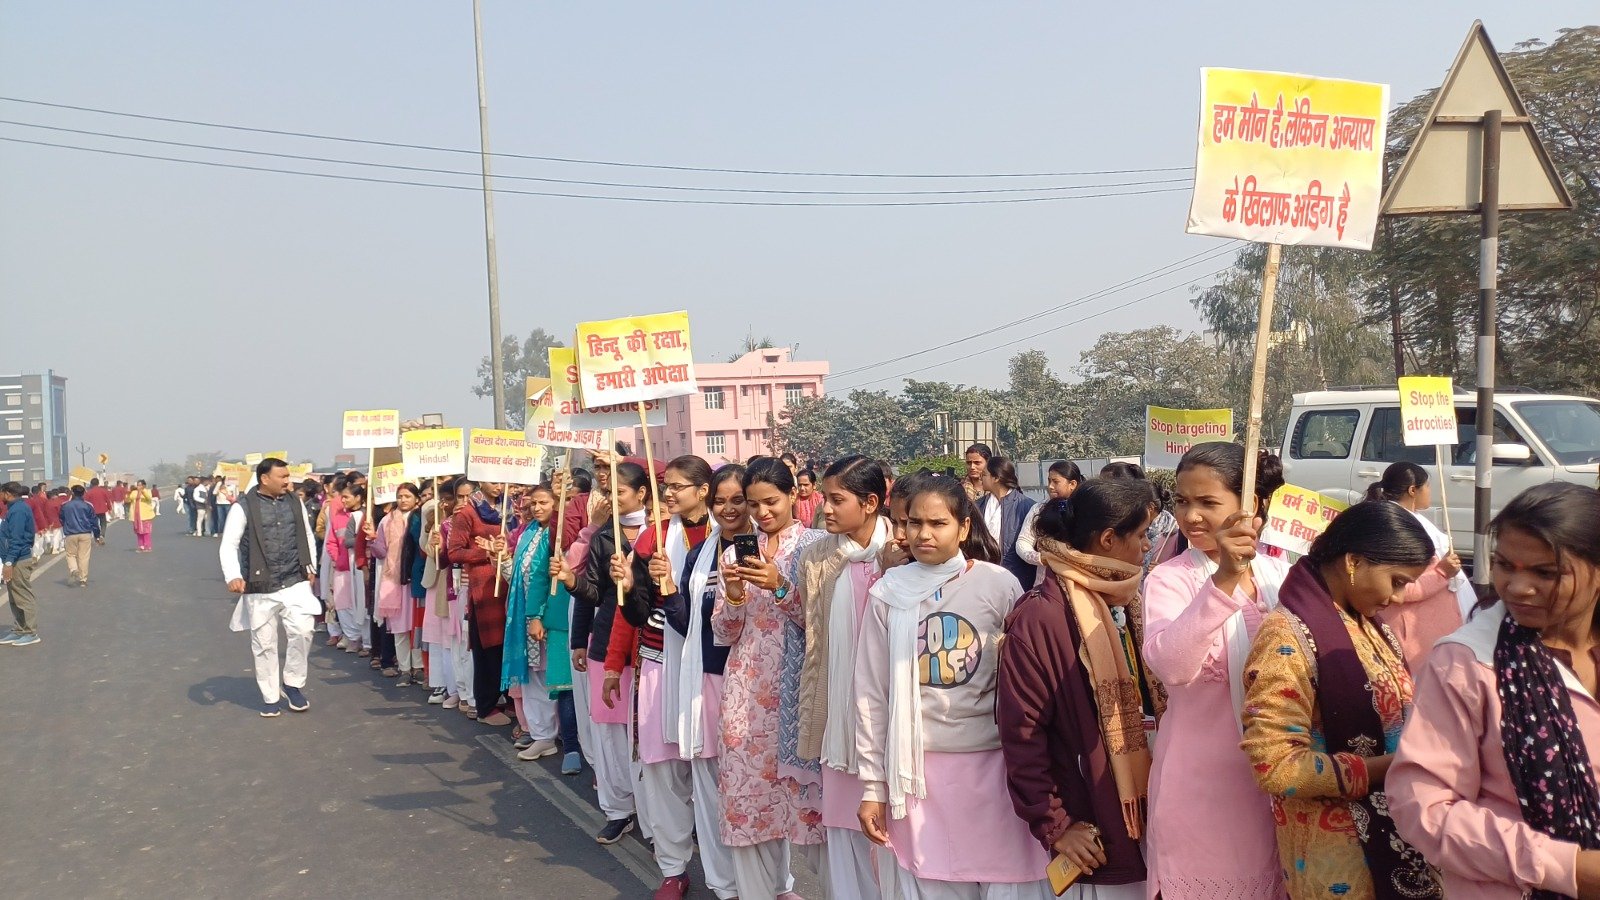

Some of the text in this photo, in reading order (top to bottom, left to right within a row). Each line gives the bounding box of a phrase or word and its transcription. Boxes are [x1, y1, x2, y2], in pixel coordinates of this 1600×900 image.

[1213, 104, 1237, 143] हम
[1238, 91, 1270, 143] मौन
[1329, 115, 1376, 152] अन्याय
[1222, 174, 1350, 241] के खिलाफ अडिग है
[586, 329, 687, 361] हिन्दू की रक्षा,
[594, 365, 636, 391] हमारी
[642, 361, 689, 386] अपेक्षा
[1410, 390, 1449, 409] Stop the
[1151, 418, 1227, 437] Stop targeting
[1406, 415, 1456, 431] atrocities!
[406, 439, 460, 451] Stop targeting
[1166, 440, 1193, 454] Hind
[418, 452, 450, 465] Hindus!
[1282, 493, 1304, 511] धर्म
[1305, 498, 1319, 515] के
[1271, 516, 1287, 533] पर
